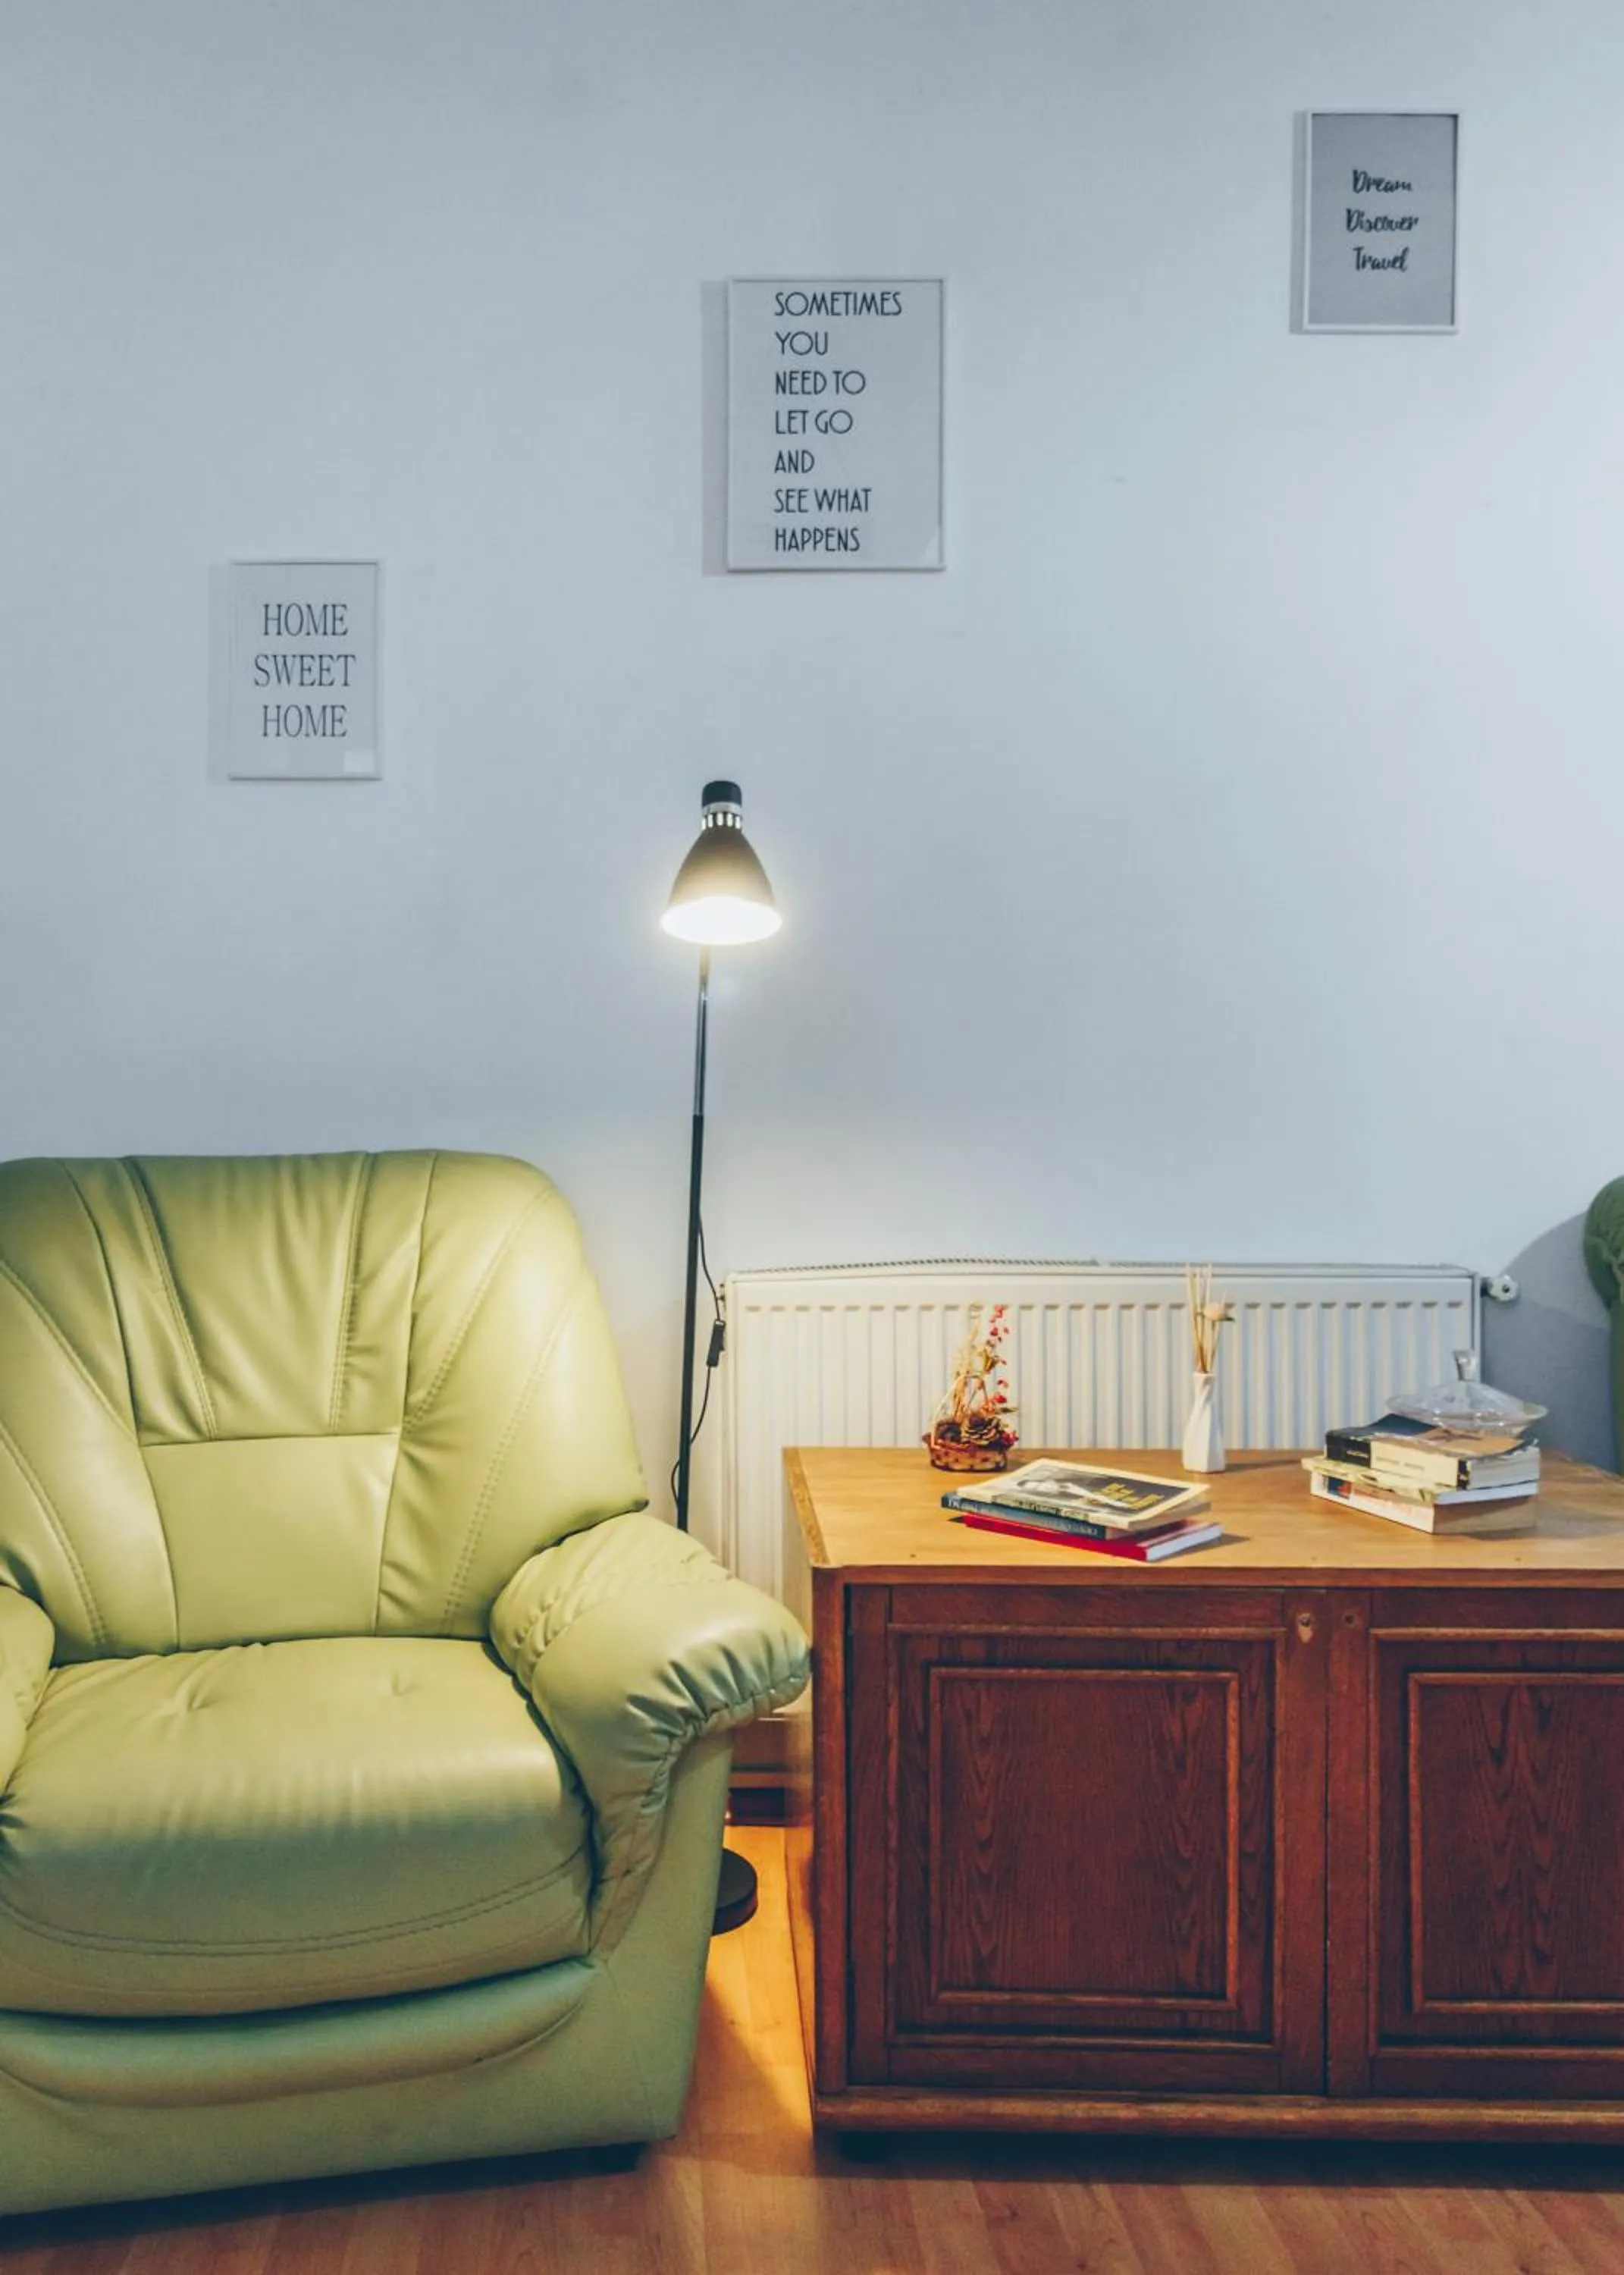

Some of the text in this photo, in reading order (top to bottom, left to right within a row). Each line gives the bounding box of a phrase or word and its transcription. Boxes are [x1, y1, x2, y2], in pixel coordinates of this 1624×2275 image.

[1353, 169, 1412, 193] Dream
[1347, 209, 1419, 232] Discover
[1353, 246, 1409, 271] Travel
[775, 291, 901, 316] SOMETIMES
[775, 331, 828, 356] YOU
[776, 370, 866, 395] NEED TO
[776, 410, 853, 435] LET GO
[775, 450, 814, 473] AND
[774, 488, 871, 513] SEE WHAT
[776, 527, 860, 551] HAPPENS
[264, 603, 348, 636] HOME
[255, 654, 356, 686] SWEET
[263, 704, 346, 737] HOME
